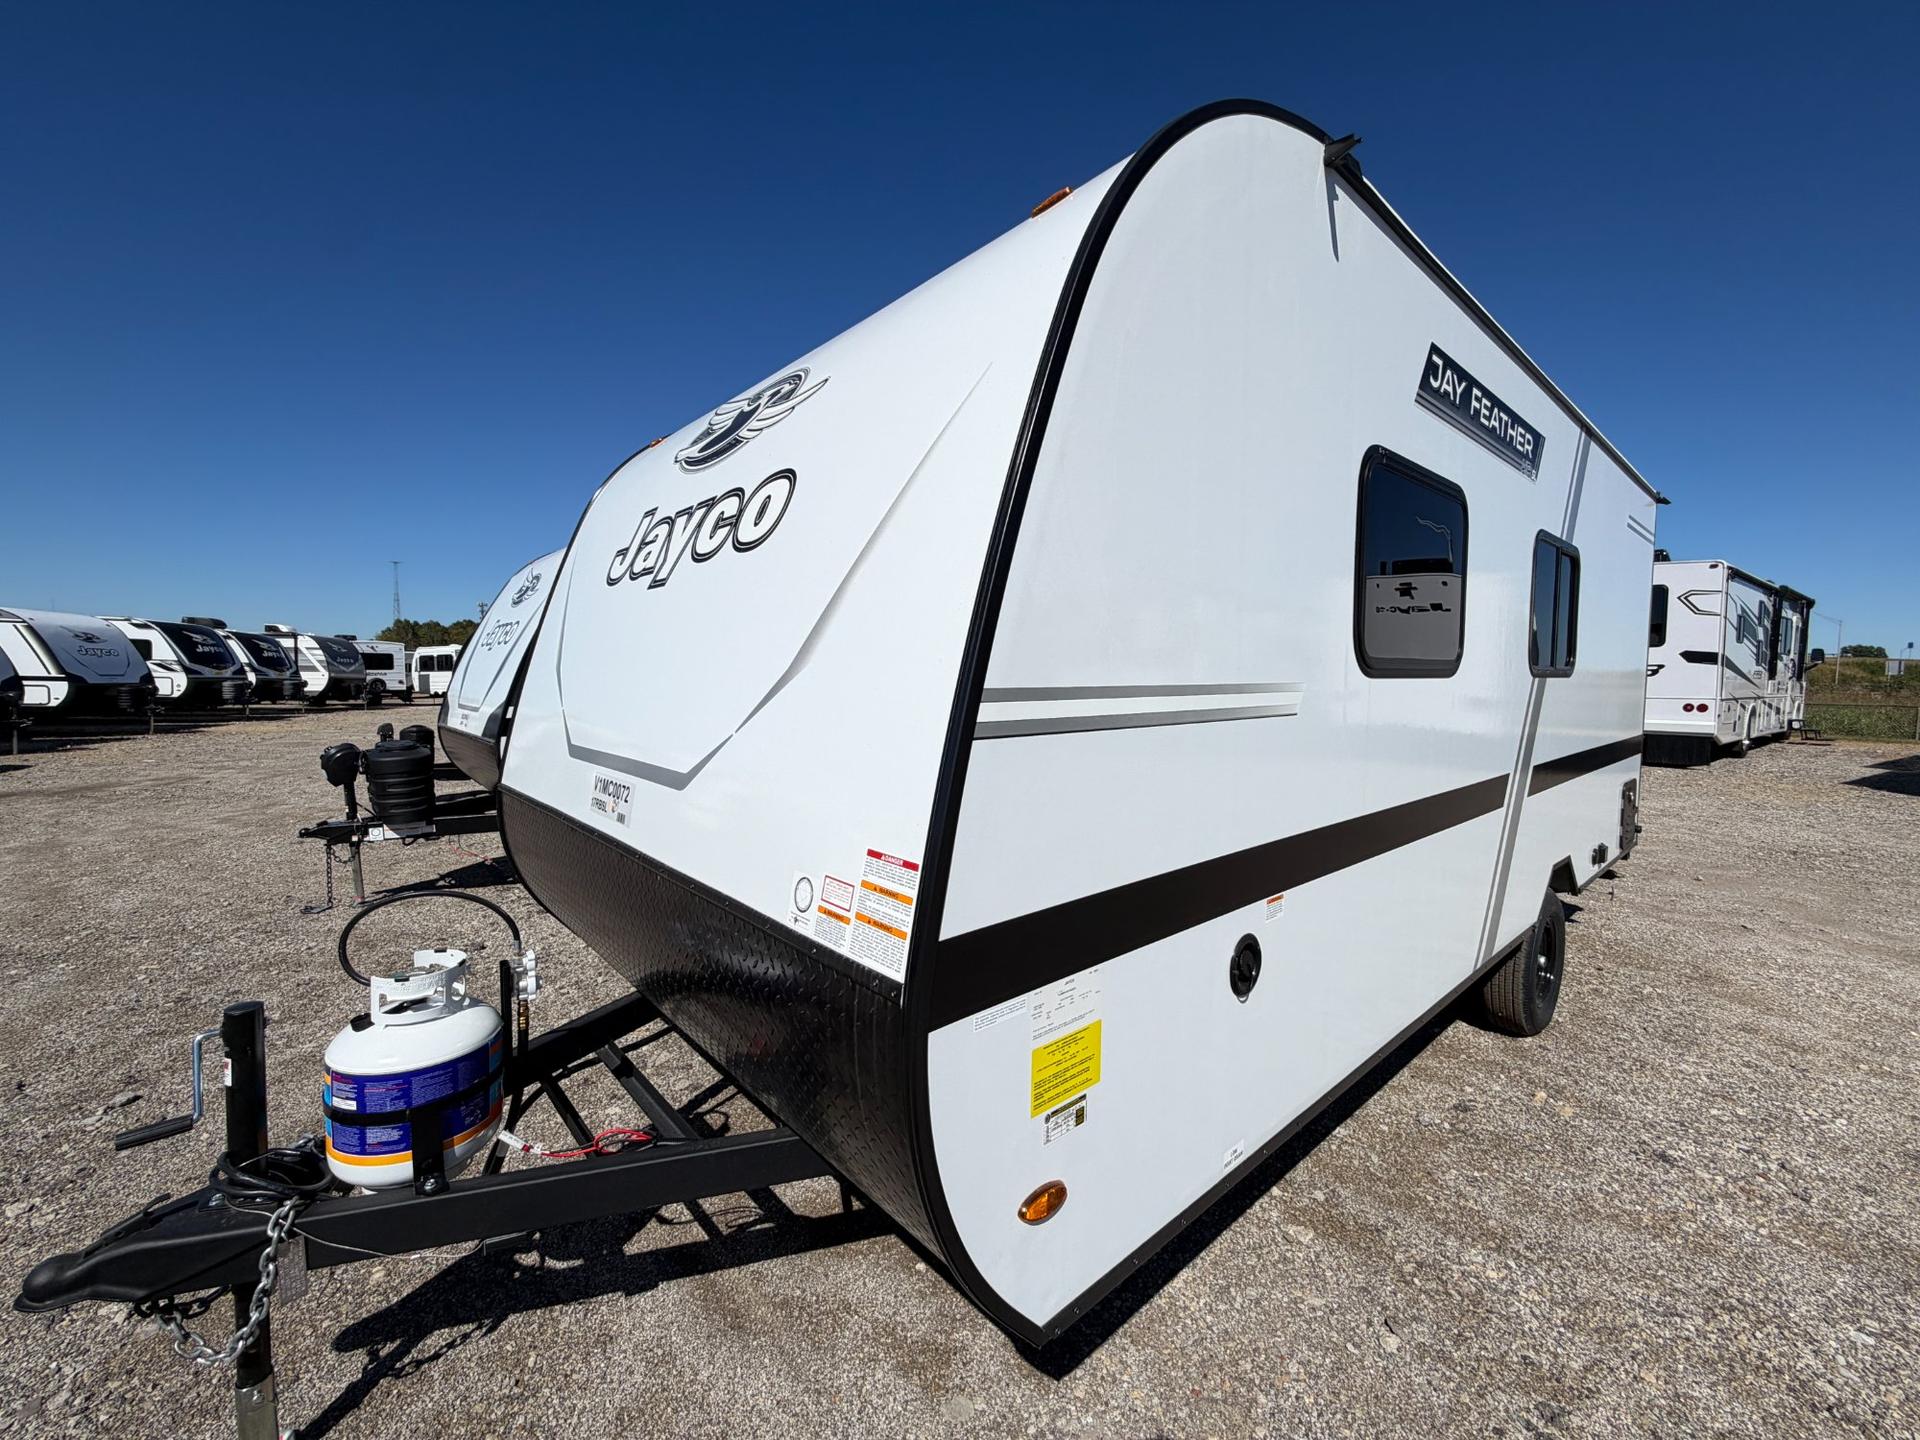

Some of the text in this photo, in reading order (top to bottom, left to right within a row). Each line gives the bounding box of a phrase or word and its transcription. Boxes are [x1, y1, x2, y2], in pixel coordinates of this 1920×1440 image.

[1429, 353, 1534, 459] JAY FEATHER
[606, 468, 797, 590] Jayco
[77, 645, 120, 658] Jayco
[594, 775, 631, 803] V1MC0072
